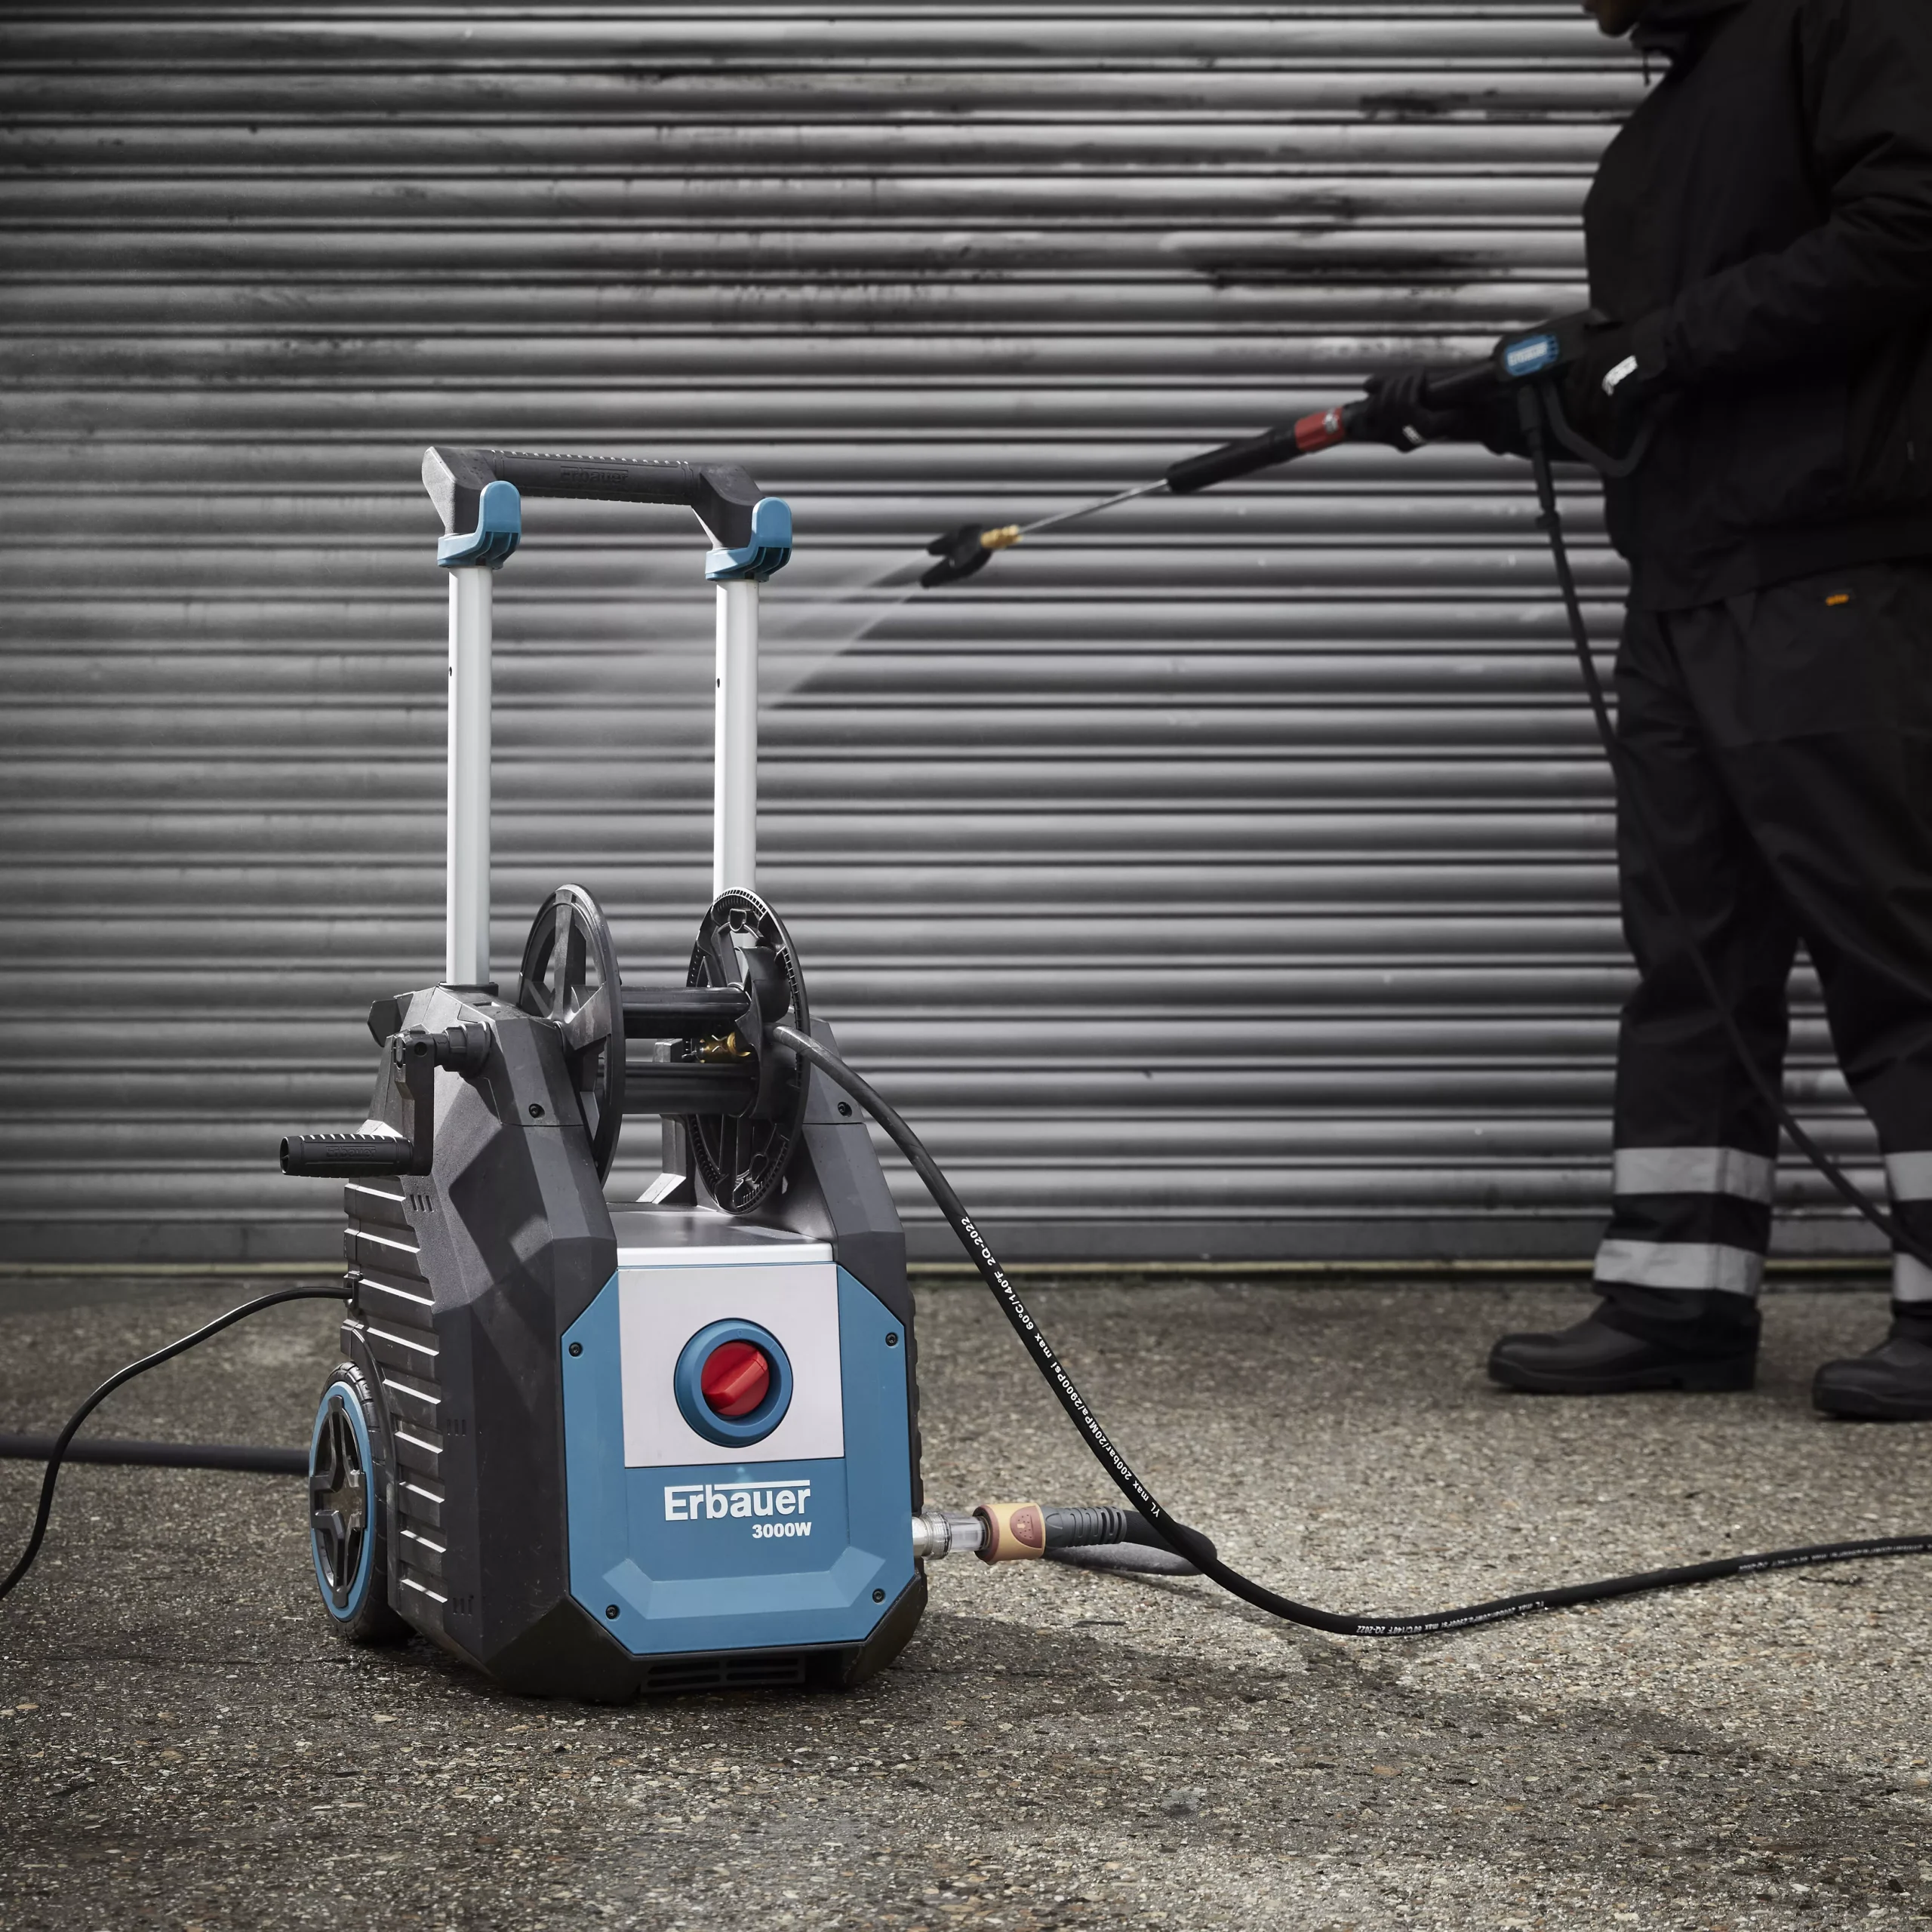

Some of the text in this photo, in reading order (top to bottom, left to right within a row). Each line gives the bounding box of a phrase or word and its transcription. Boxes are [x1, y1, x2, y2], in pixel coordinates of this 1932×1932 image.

[560, 466, 629, 484] Erbauer
[961, 1217, 995, 1266] 2Q-2022
[1034, 1333, 1052, 1358] max
[1050, 1362, 1133, 1481] 200bar/20MPa/2900Psi
[664, 1479, 811, 1521] Erbauer
[1132, 1481, 1149, 1501] max
[1144, 1499, 1160, 1518] YL
[752, 1522, 812, 1539] 3000W
[1357, 1625, 1386, 1634] 2Q-2022
